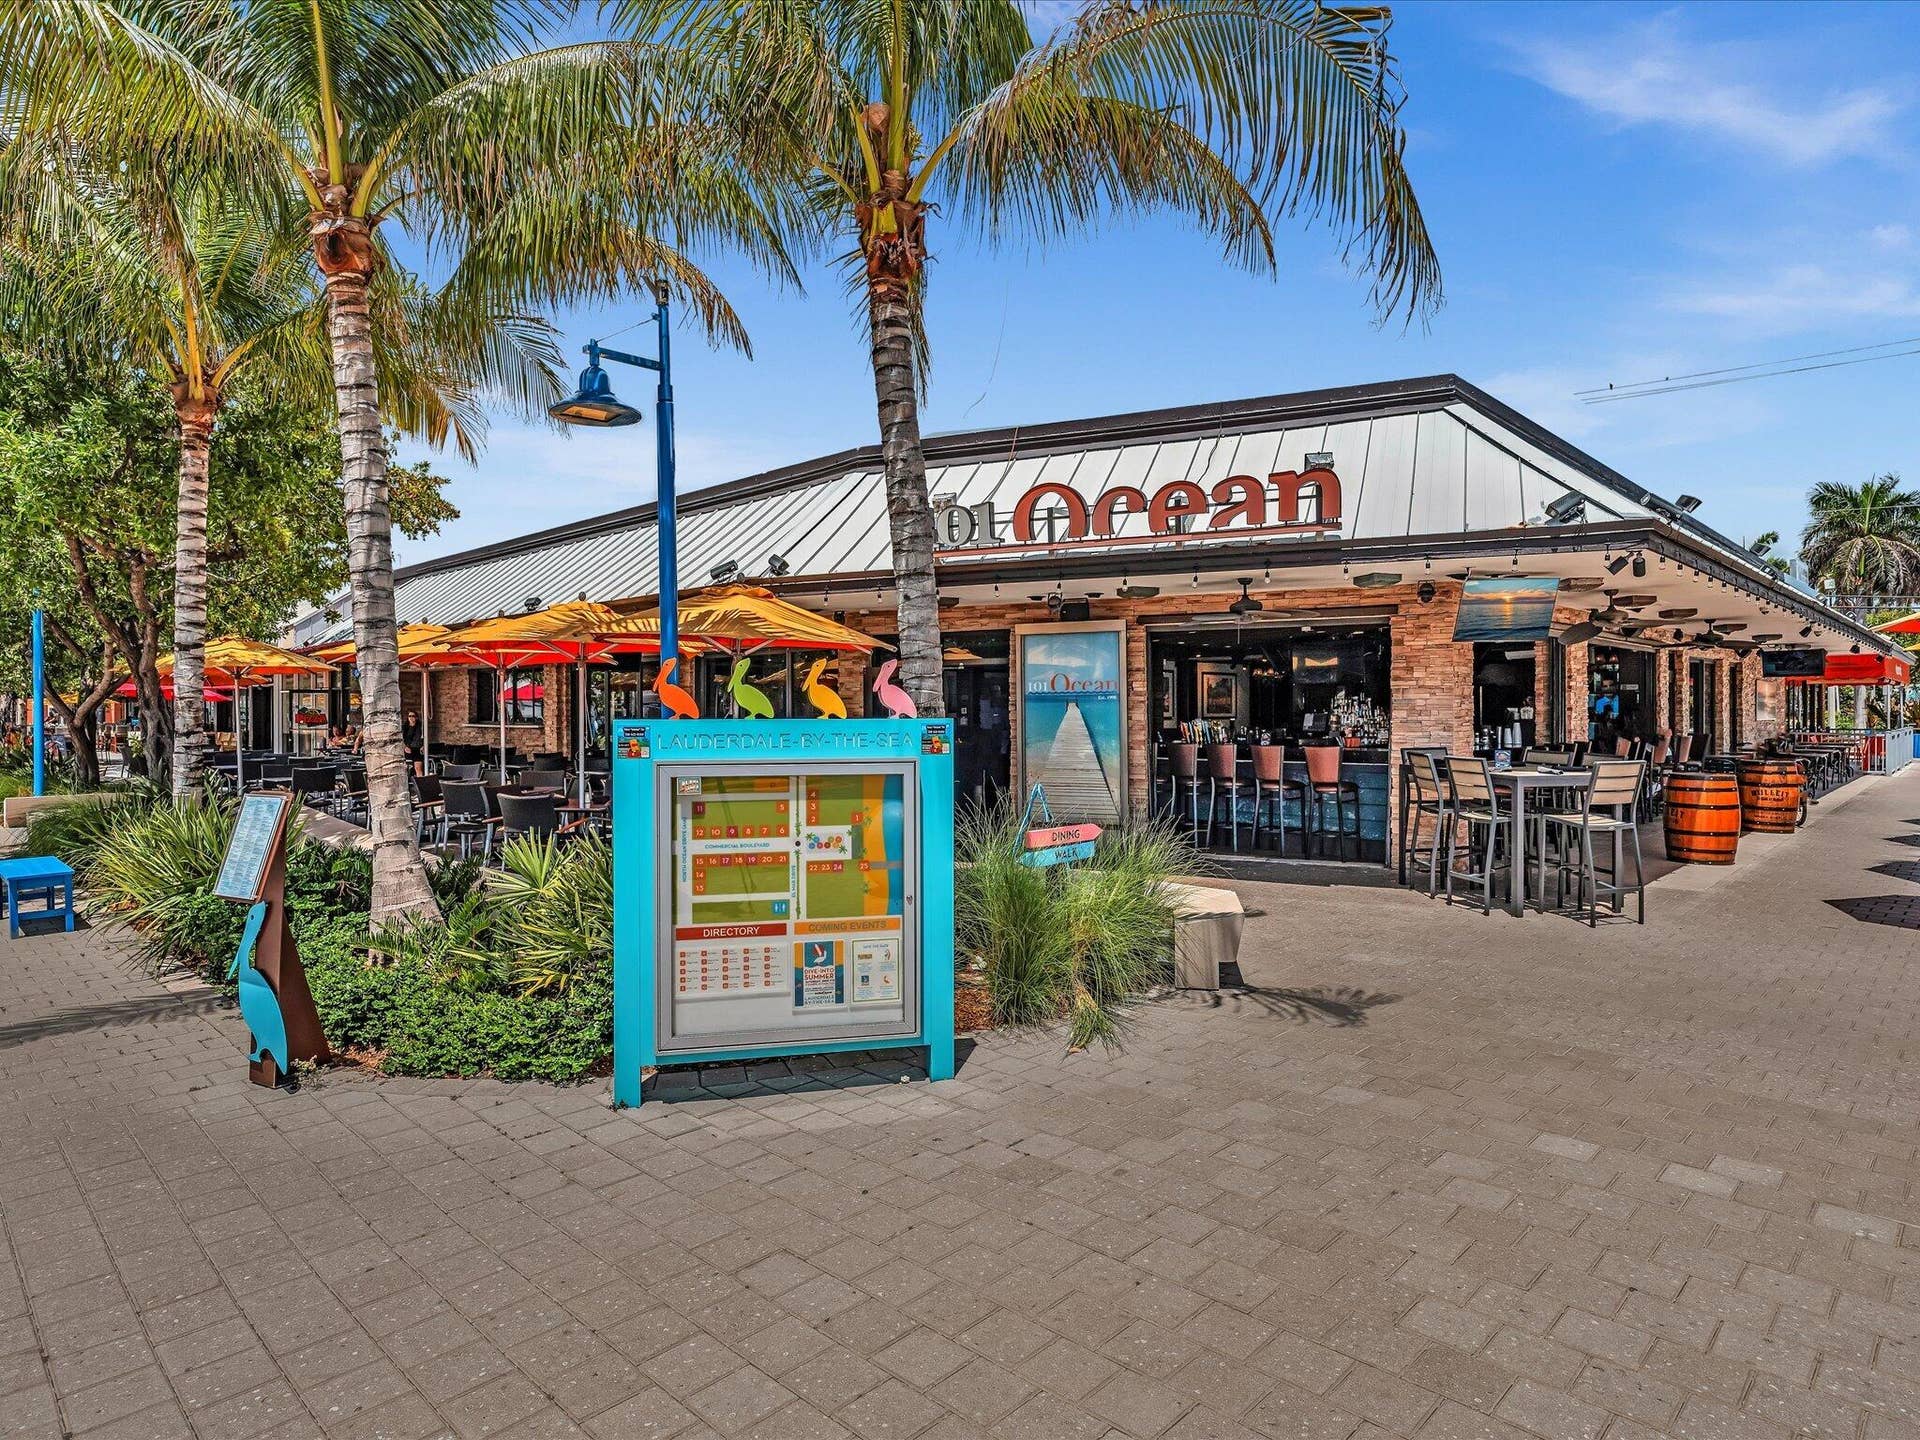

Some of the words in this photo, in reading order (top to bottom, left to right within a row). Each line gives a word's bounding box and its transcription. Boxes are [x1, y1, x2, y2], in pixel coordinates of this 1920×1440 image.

[1012, 467, 1343, 544] Ocean
[1028, 682, 1047, 692] 101
[1050, 672, 1118, 692] Ocean
[656, 732, 913, 750] LAUDERDALE-BY-THE-SEA
[1051, 829, 1080, 842] DINING
[1054, 847, 1079, 859] WALK
[703, 926, 761, 938] DIRECTORY
[808, 922, 848, 932] COMING
[850, 920, 887, 930] EVENTS
[804, 973, 834, 981] SUMMER
